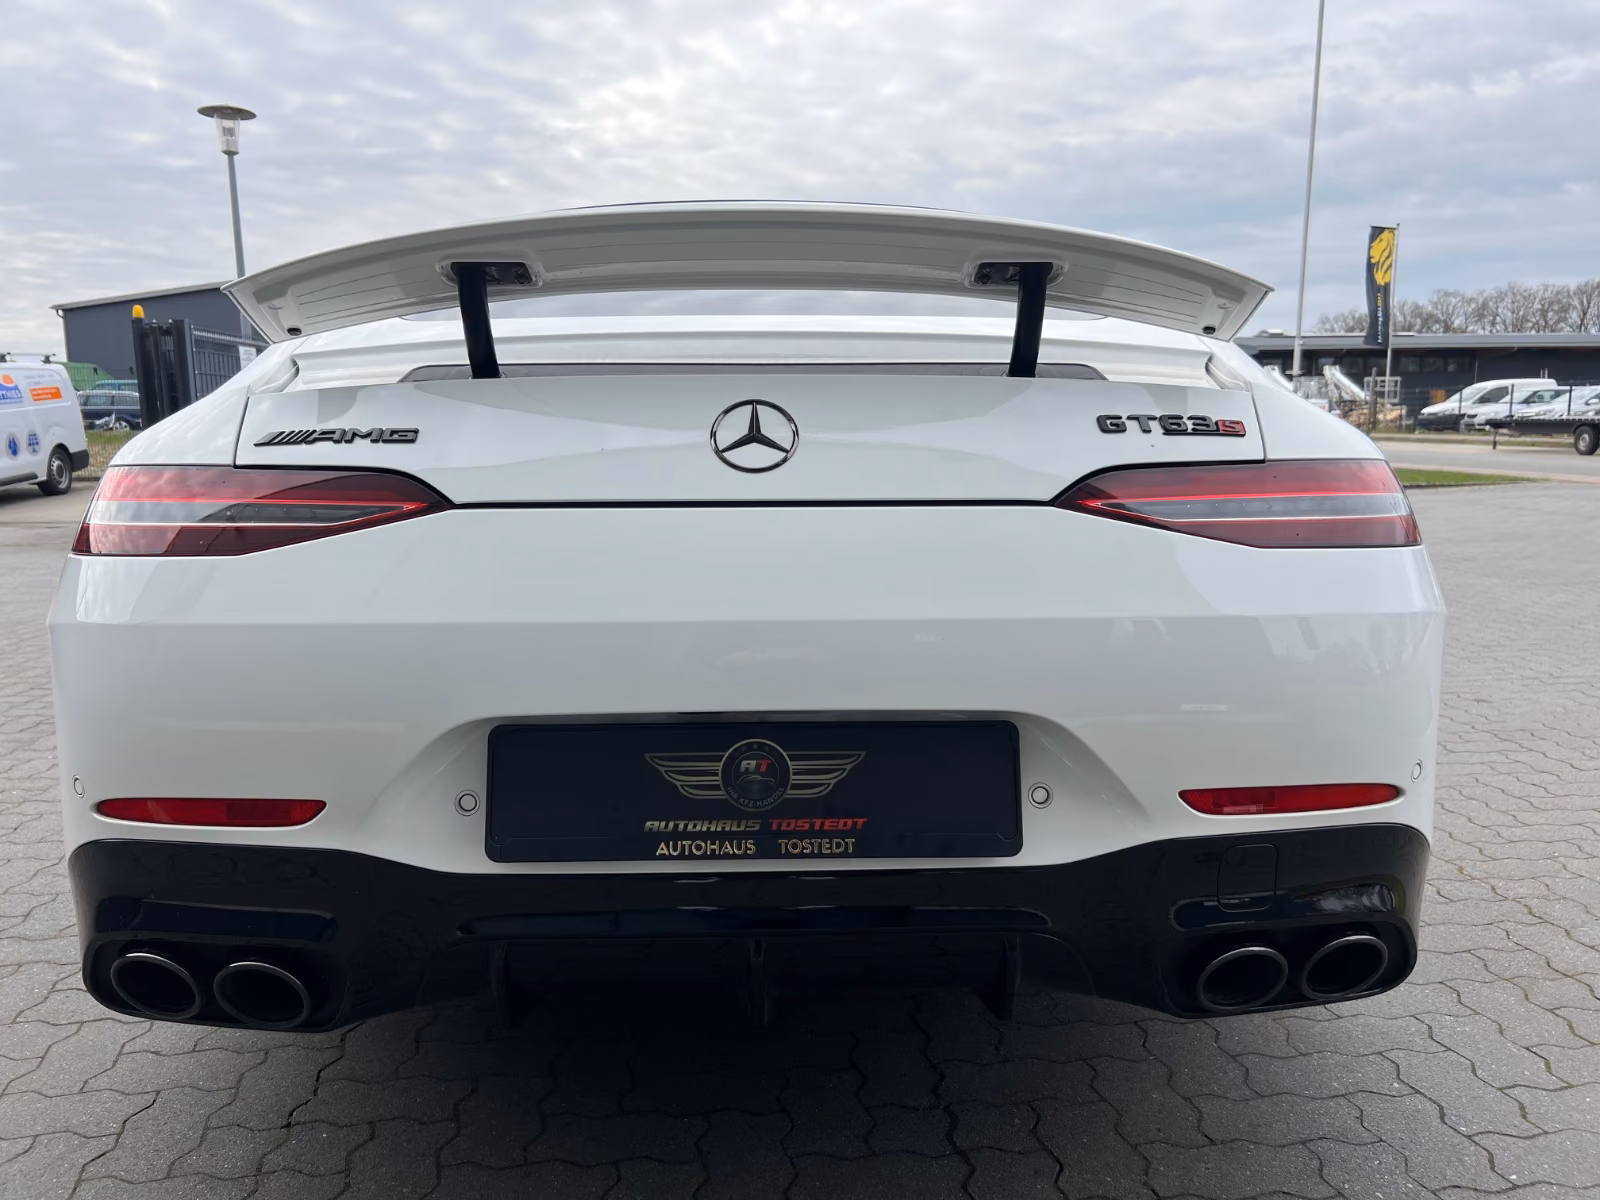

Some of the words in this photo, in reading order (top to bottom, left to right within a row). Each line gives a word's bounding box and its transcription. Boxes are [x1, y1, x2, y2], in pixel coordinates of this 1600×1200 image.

[303, 427, 419, 444] AMG
[740, 759, 773, 773] AT
[727, 786, 739, 800] IHR
[644, 820, 761, 833] AUTOHAUS
[769, 818, 867, 831] TOSTEDT
[655, 840, 757, 856] AUTOHAUS
[778, 838, 856, 854] TOSTEDT
